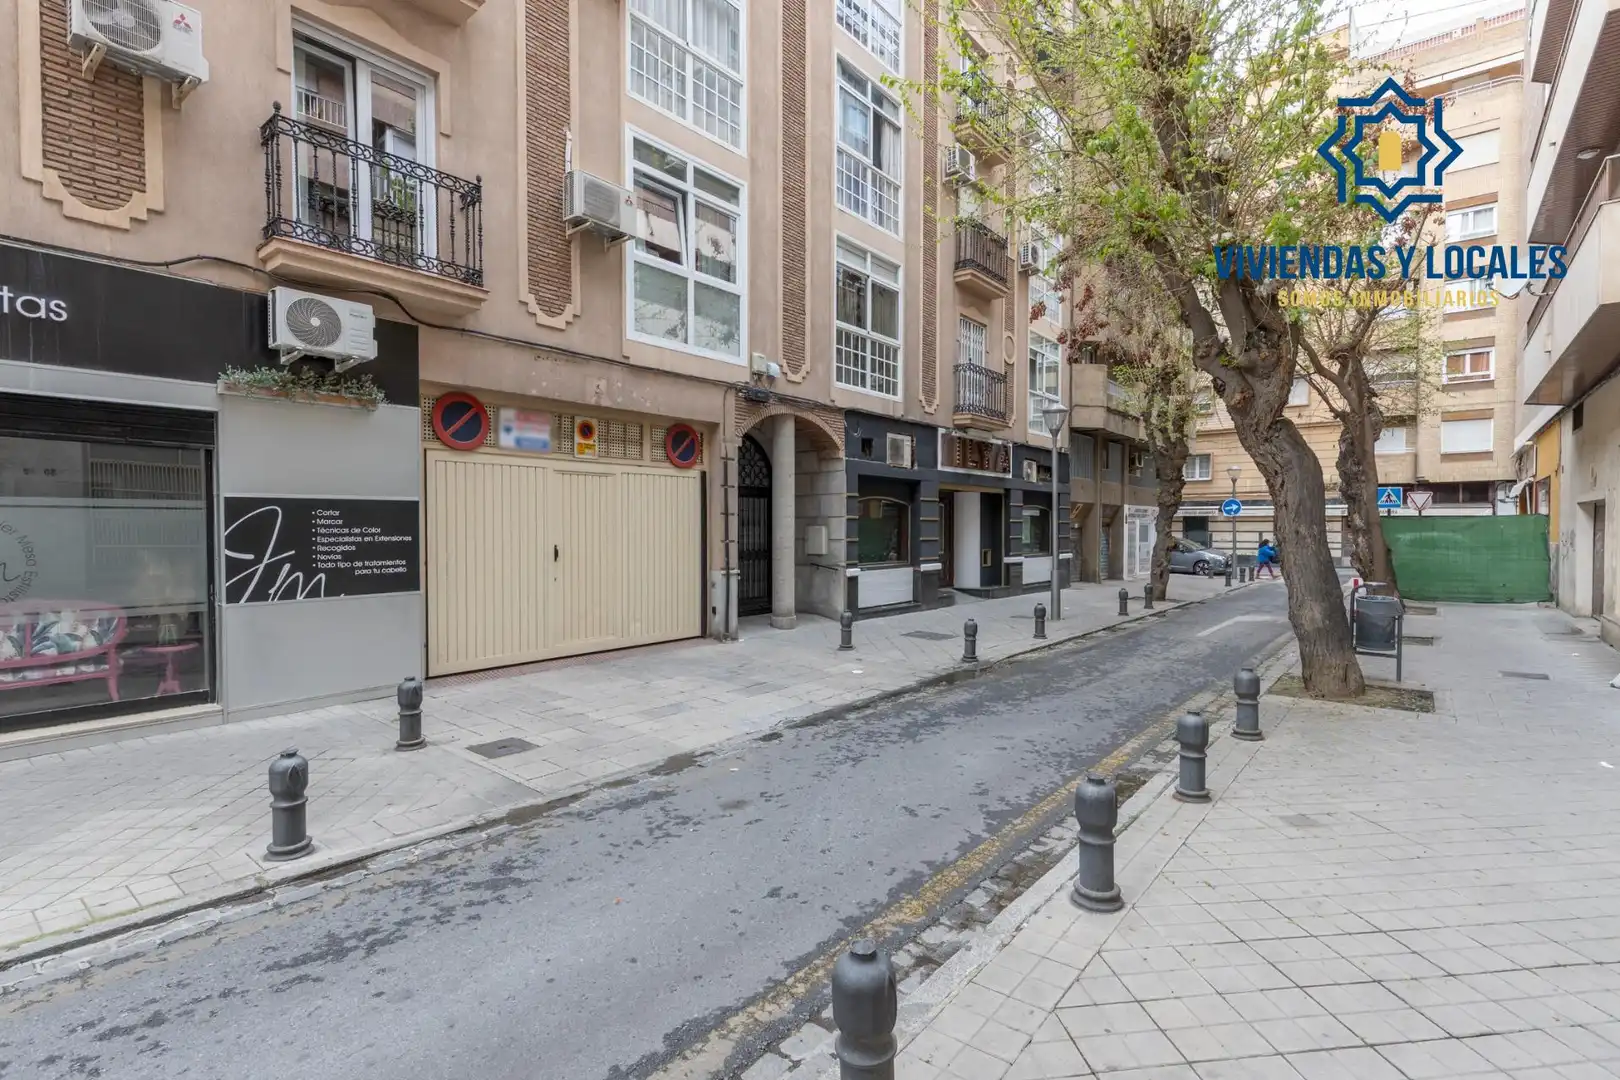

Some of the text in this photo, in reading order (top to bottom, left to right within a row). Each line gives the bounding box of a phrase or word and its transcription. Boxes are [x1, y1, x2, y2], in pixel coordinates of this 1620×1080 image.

[362, 526, 381, 534] Color
[316, 535, 362, 543] Especialistas
[316, 544, 356, 552] Recogidos
[317, 561, 336, 569] Todo
[364, 559, 406, 567] tratamientos
